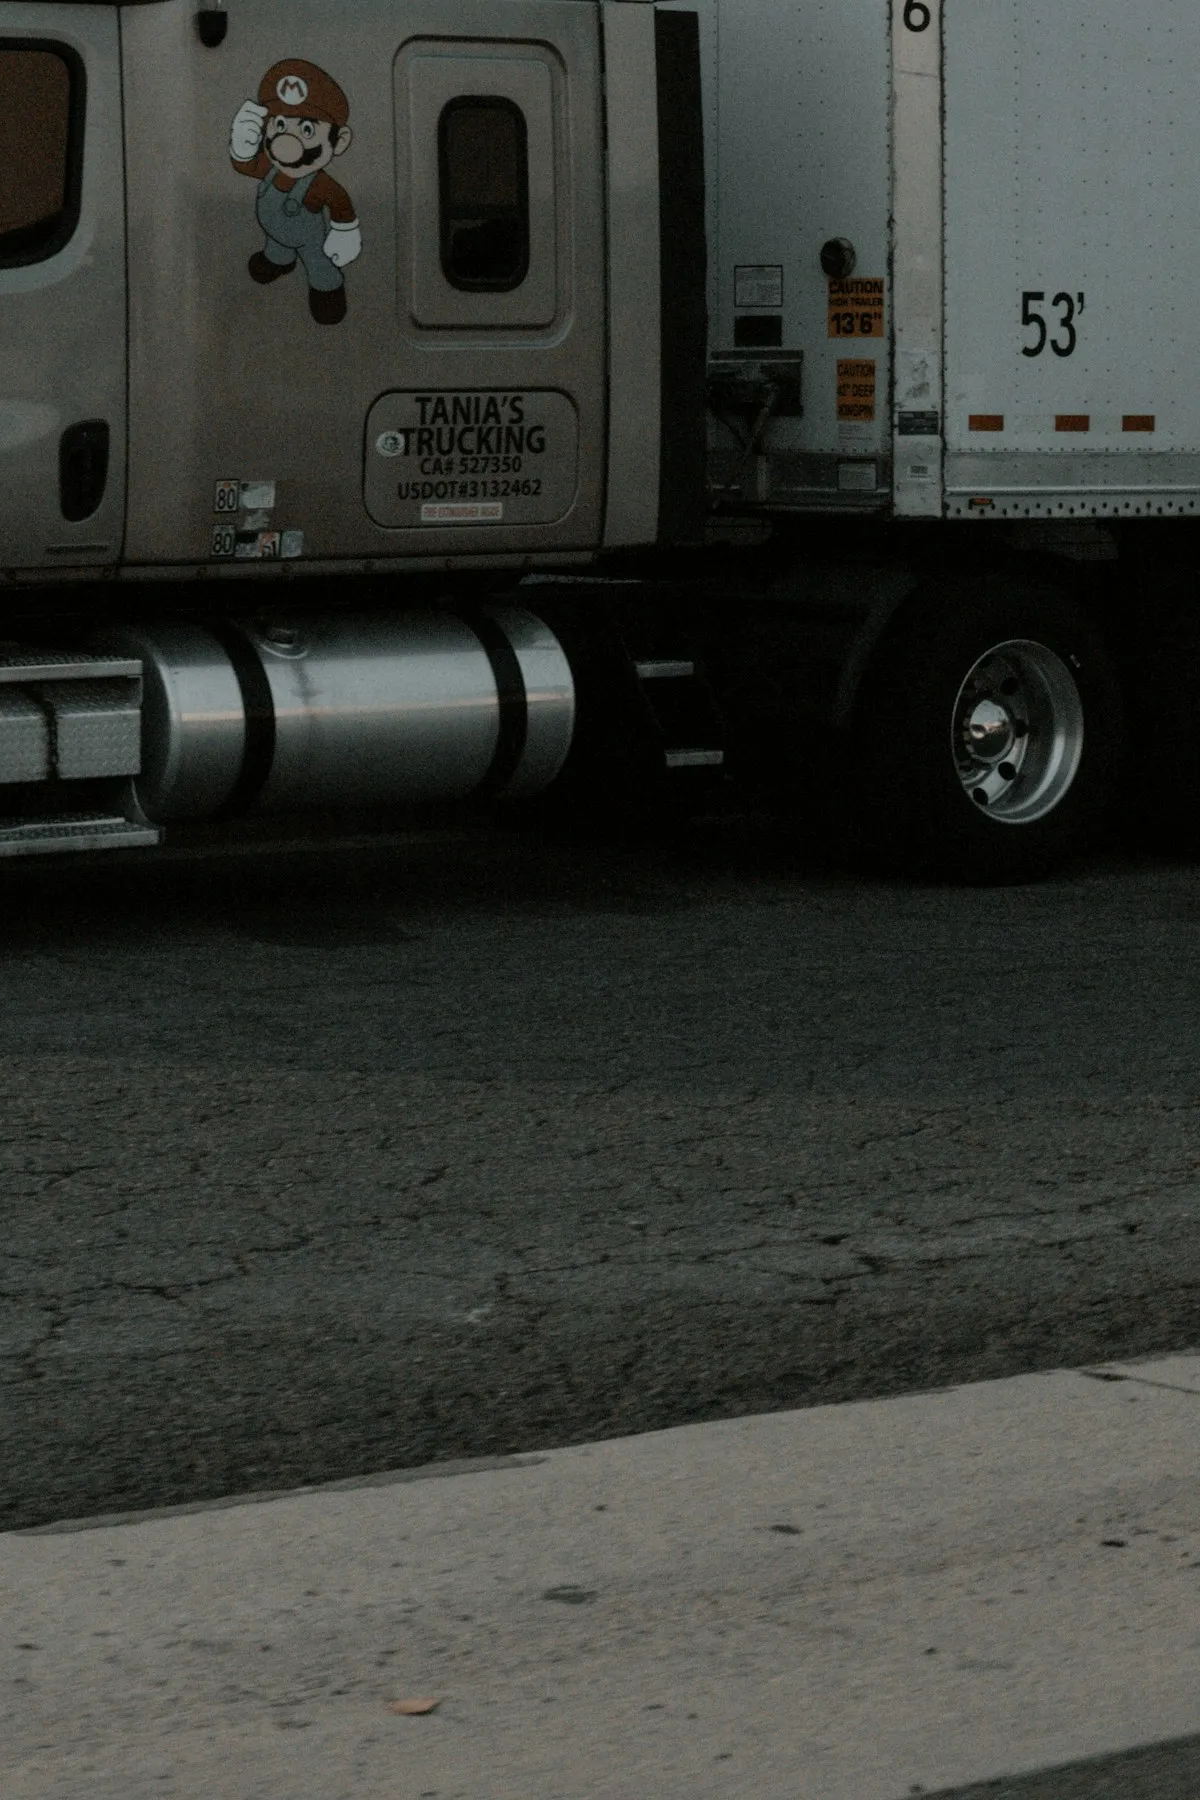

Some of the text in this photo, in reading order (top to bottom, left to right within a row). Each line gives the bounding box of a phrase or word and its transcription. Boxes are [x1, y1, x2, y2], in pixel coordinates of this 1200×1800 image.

[829, 280, 883, 293] CAUTION
[850, 297, 884, 307] TRAILER
[831, 312, 882, 335] 13'6"
[1022, 292, 1084, 357] 53'
[837, 363, 876, 377] CAUTION
[852, 383, 875, 398] DEEP
[415, 396, 524, 425] TANIA'S
[398, 426, 545, 456] TRUCKING
[420, 456, 522, 476] CA# 527350
[216, 488, 236, 510] 80
[397, 479, 542, 500] USDOT#3132462
[212, 533, 232, 554] 80
